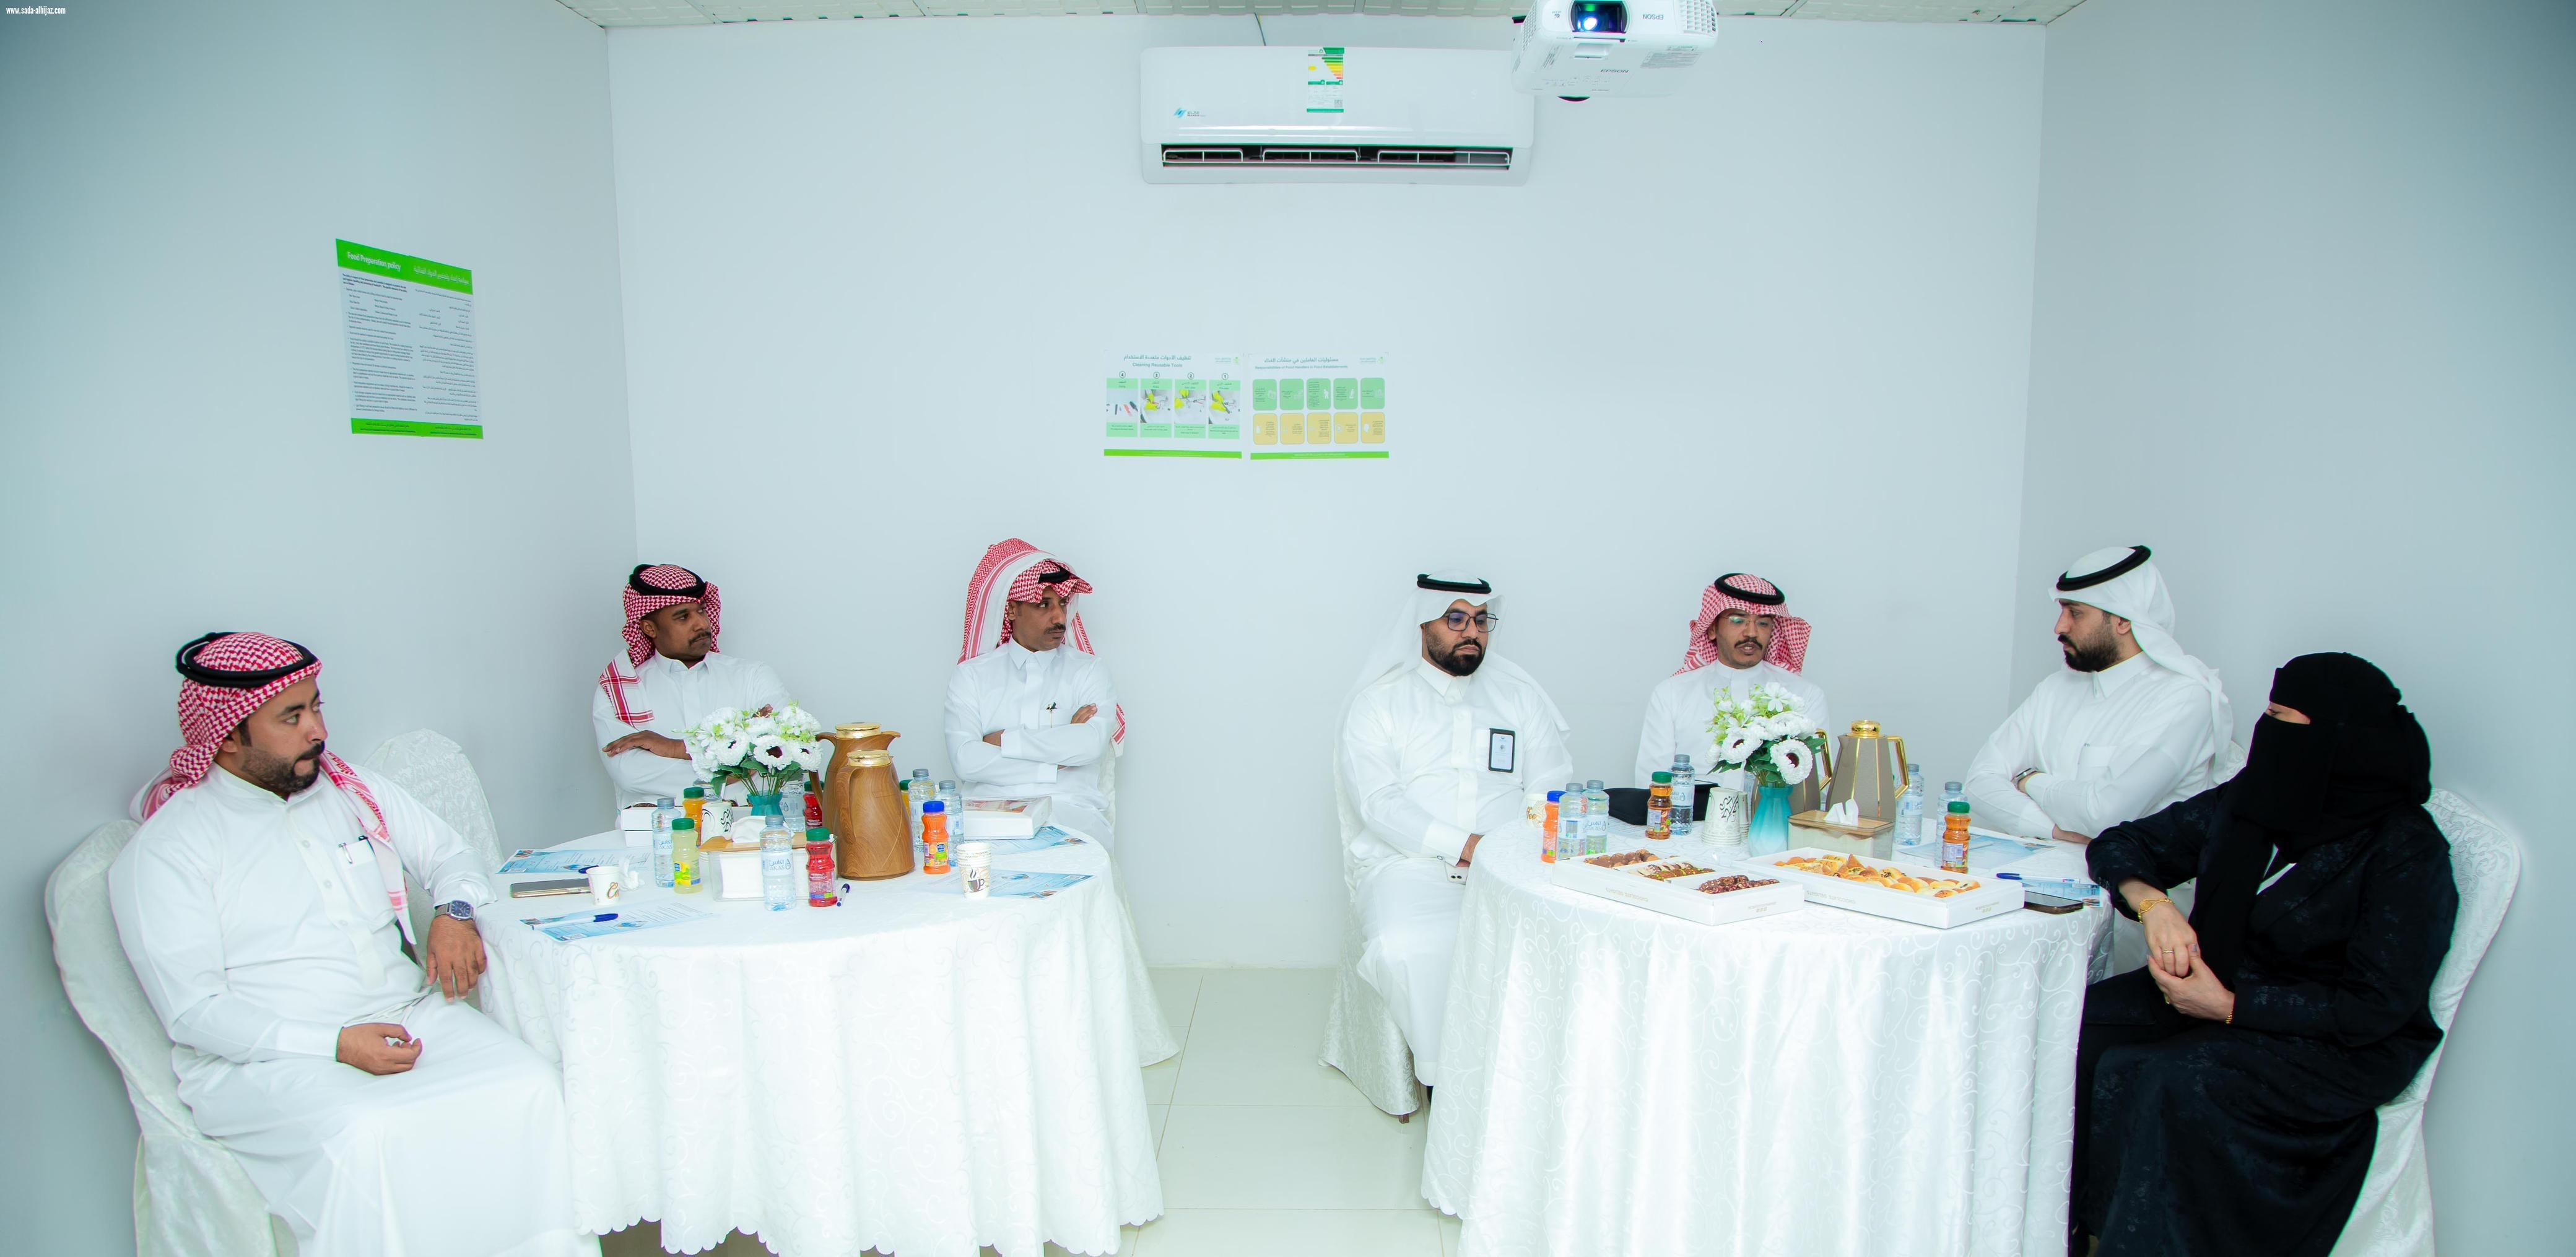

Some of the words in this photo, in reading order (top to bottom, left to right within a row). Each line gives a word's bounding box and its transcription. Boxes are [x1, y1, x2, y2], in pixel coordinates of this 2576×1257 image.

[347, 251, 360, 261] Food
[360, 254, 387, 267] Preparation
[388, 262, 401, 272] policy
